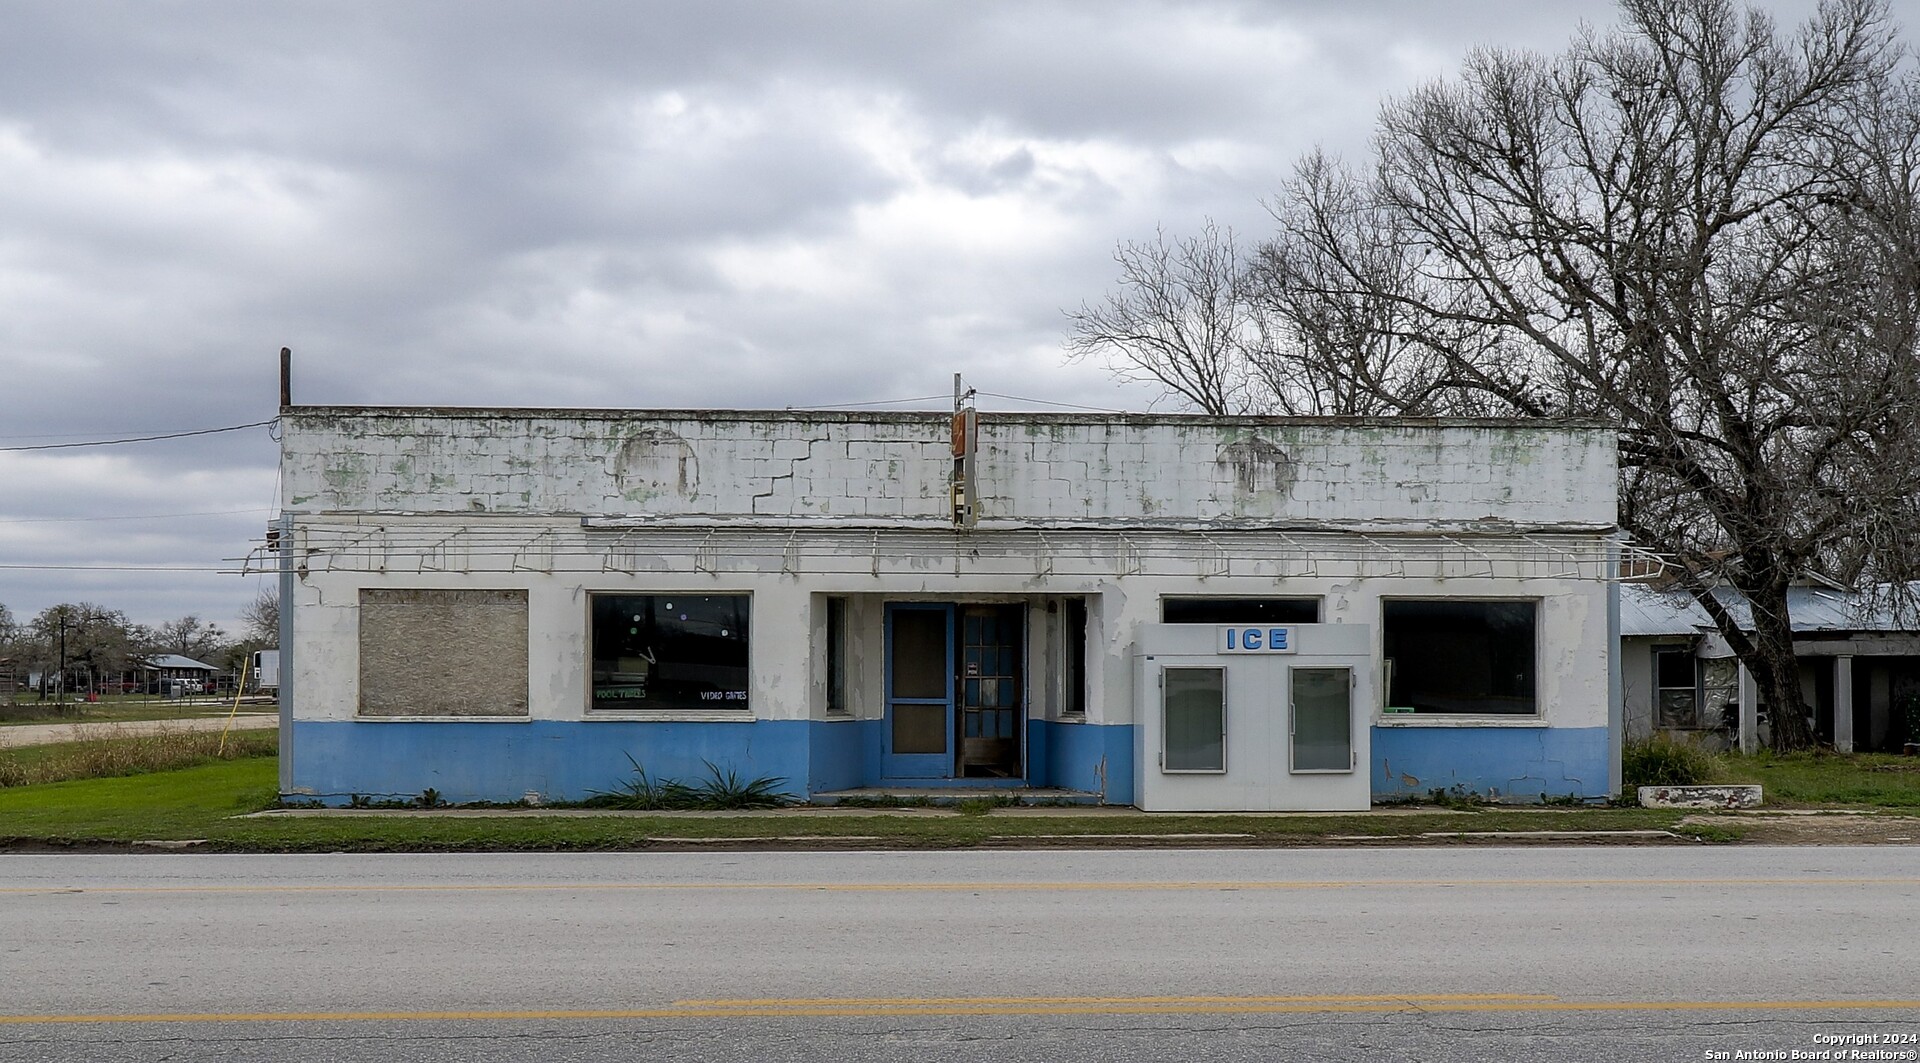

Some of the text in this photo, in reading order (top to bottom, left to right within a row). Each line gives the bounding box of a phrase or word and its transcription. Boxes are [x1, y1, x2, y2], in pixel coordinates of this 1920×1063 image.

[1227, 628, 1288, 650] ICE
[596, 690, 618, 698] POOL
[700, 691, 747, 700] VIDEO GAMES
